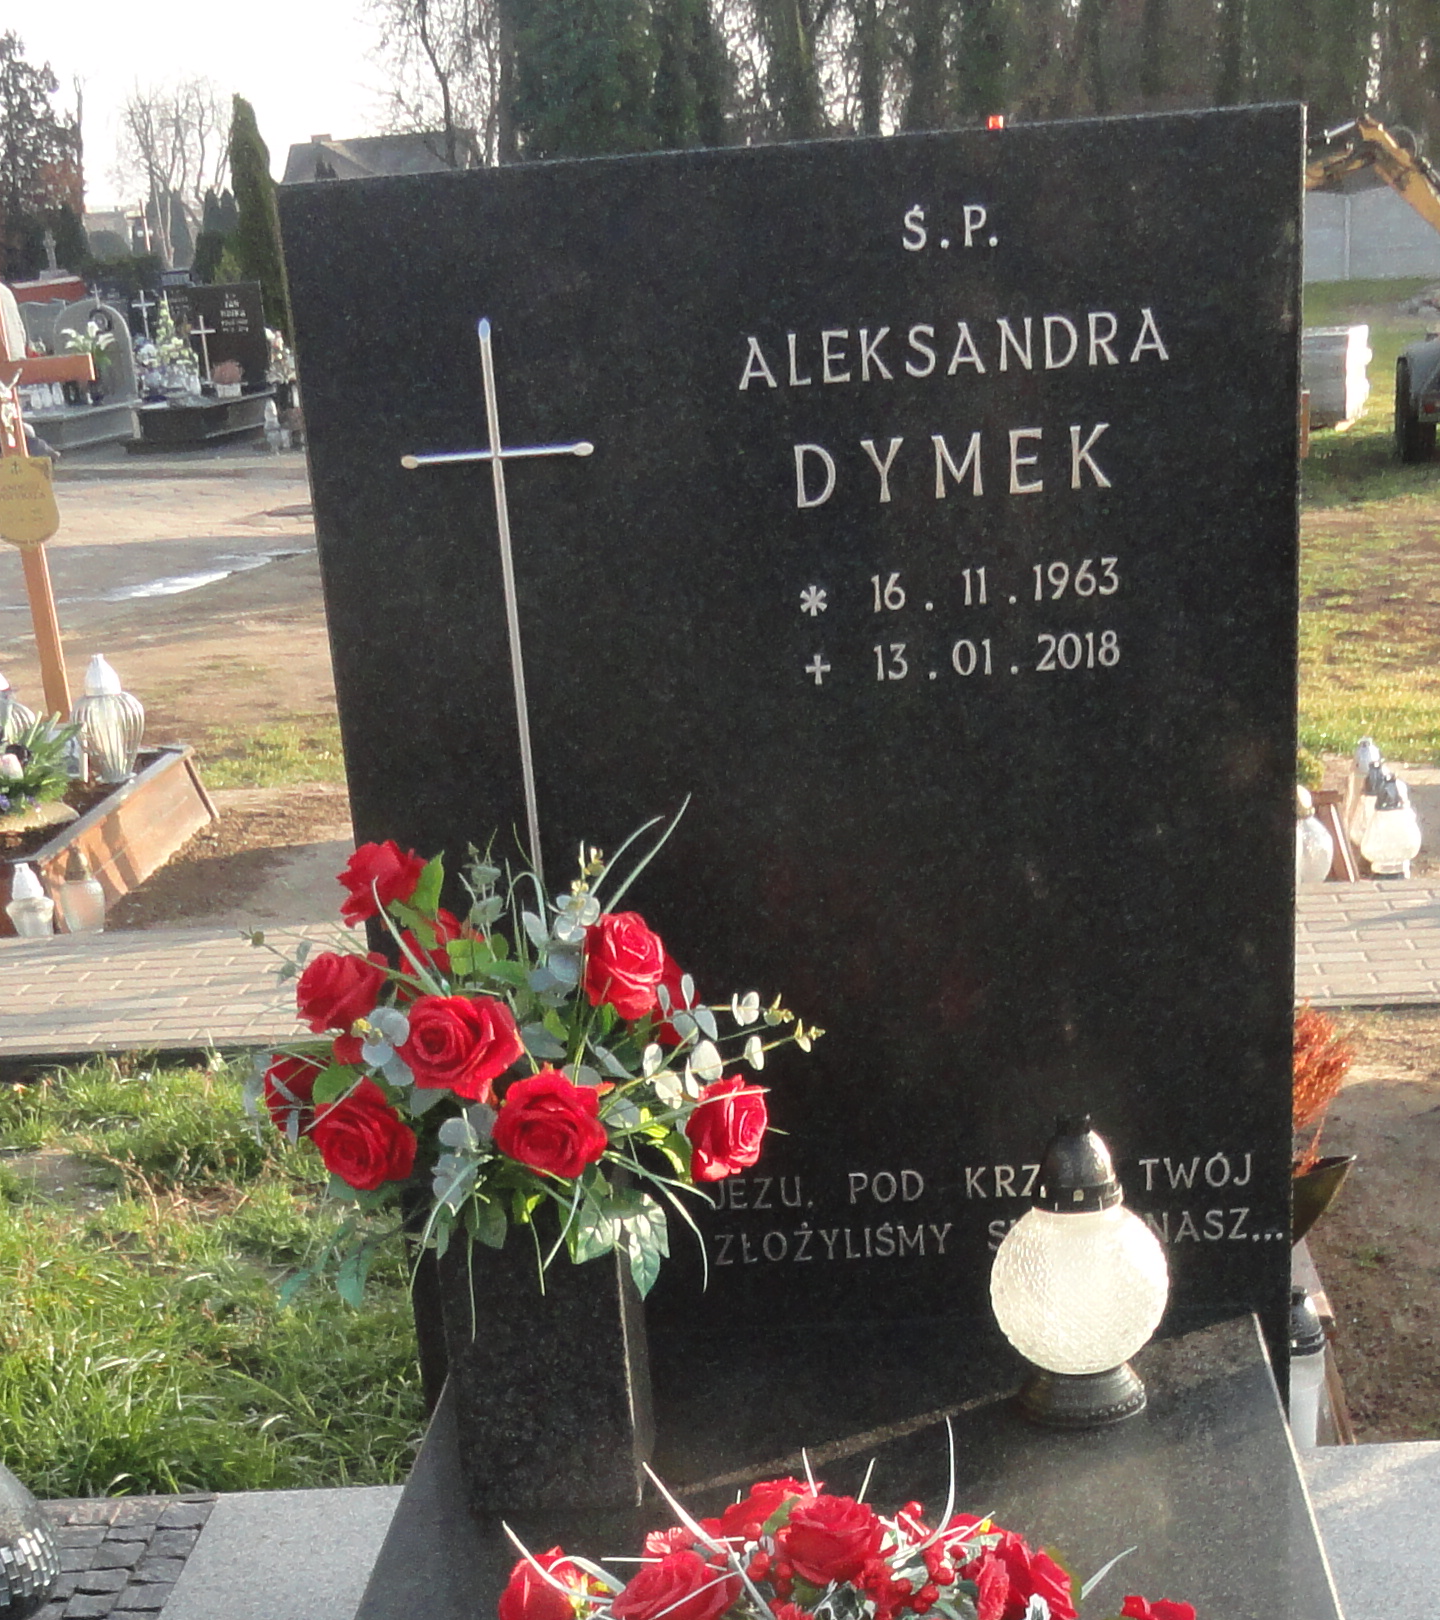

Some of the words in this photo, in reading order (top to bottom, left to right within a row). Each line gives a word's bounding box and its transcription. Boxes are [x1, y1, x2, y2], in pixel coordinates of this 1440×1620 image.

[738, 307, 1169, 391] ALEKSANDRA
[793, 422, 1112, 509] DYMEK
[1032, 557, 1119, 601] 1963
[1035, 630, 1120, 672] 2018
[848, 1170, 924, 1204] POD
[1138, 1152, 1252, 1192] TWÓJ
